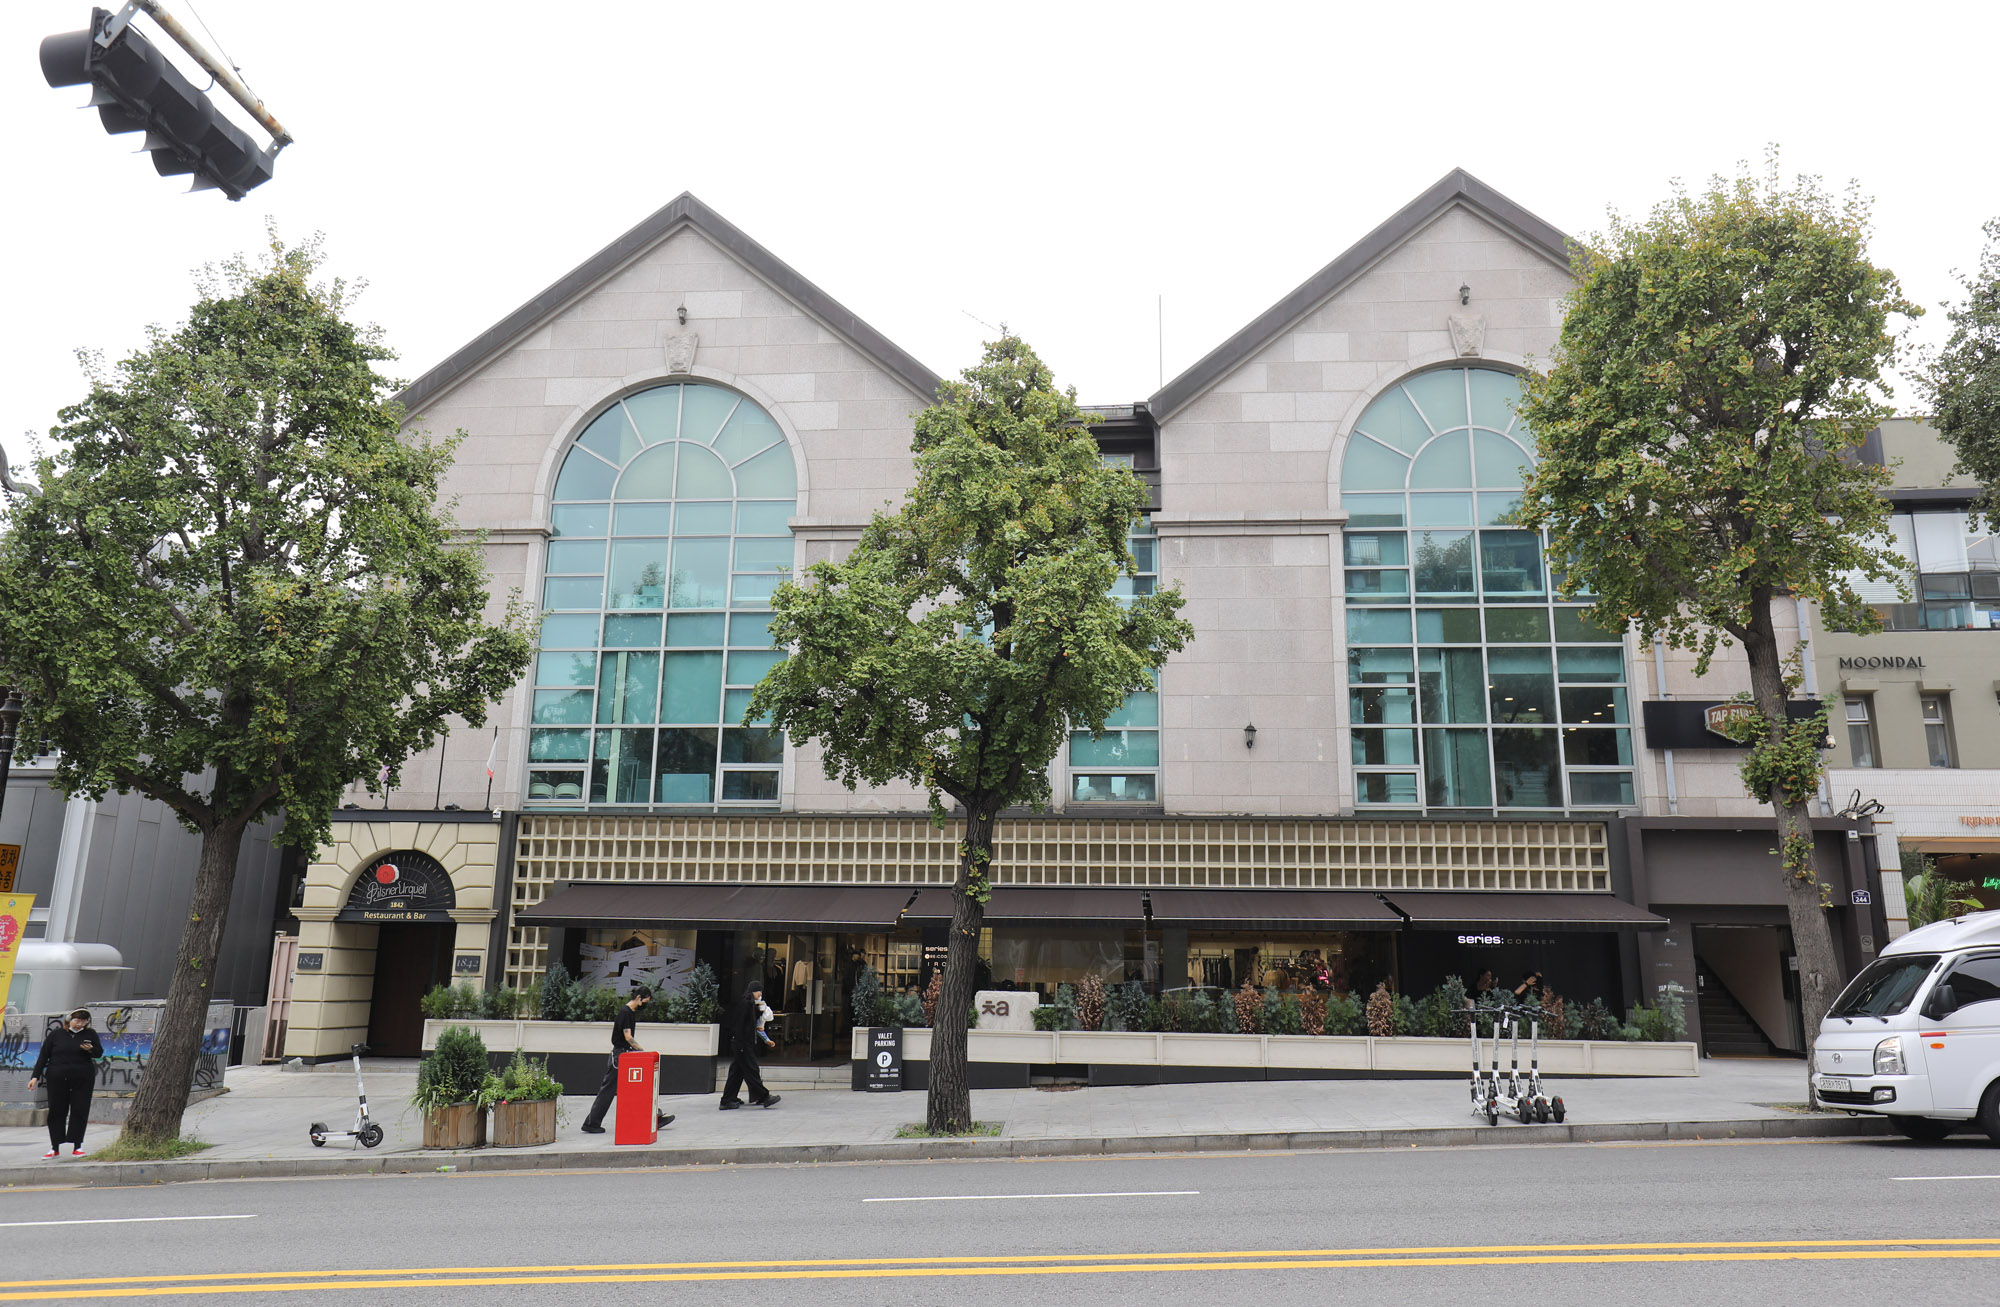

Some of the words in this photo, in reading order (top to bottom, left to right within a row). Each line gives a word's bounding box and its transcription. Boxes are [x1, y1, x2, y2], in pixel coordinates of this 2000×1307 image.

[1839, 656, 1927, 669] MOONDAL
[1711, 709, 1728, 724] TAP
[366, 881, 399, 904] Pilsner
[398, 881, 428, 900] Urquell
[364, 911, 404, 919] Restaurant
[413, 912, 427, 920] Bar
[1457, 933, 1504, 944] series:
[299, 956, 321, 966] 1842
[456, 958, 479, 968] 1842
[877, 1032, 893, 1040] VALET
[881, 1054, 888, 1065] P
